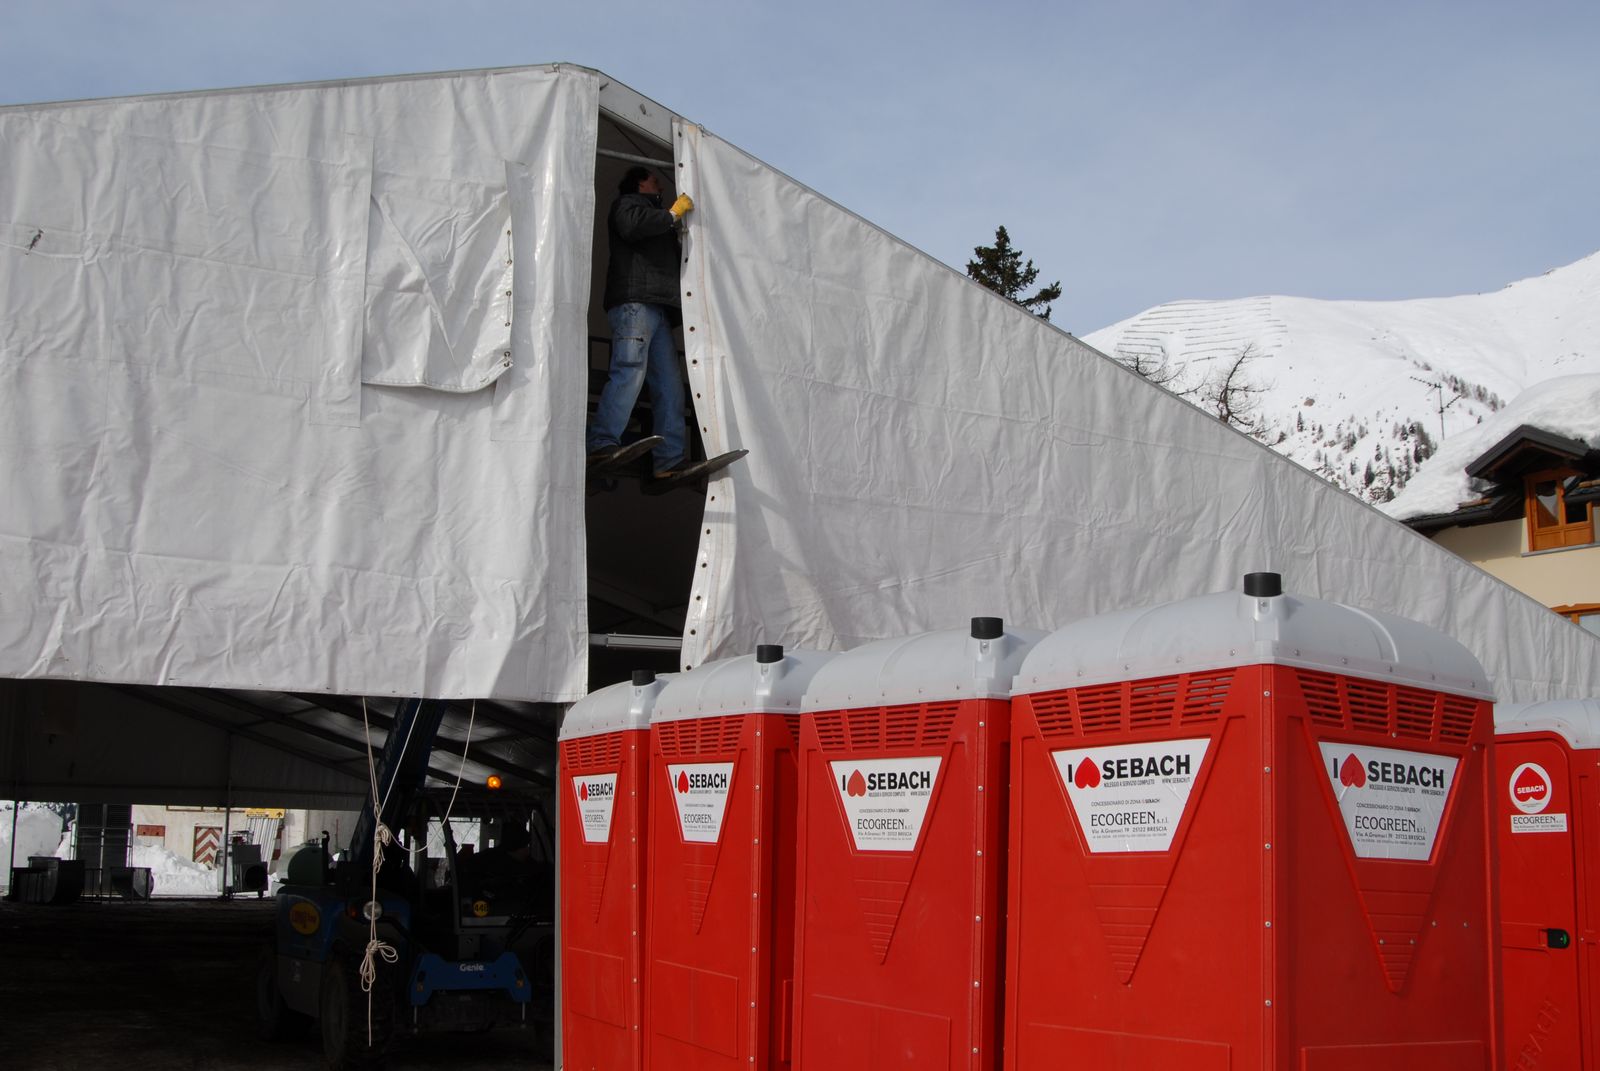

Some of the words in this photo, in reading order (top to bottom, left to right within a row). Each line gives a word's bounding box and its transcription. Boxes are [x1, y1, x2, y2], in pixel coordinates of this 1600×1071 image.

[1068, 764, 1073, 783] I
[1102, 754, 1190, 780] SEBACH
[1333, 758, 1338, 779] I
[1367, 761, 1444, 788] SEBACH
[689, 773, 727, 788] SEBACH
[842, 774, 846, 791] I
[867, 771, 930, 791] SEBACH
[588, 782, 613, 796] SEBACH
[1517, 785, 1544, 794] SEBACH
[684, 814, 712, 823] ECOGREEN
[857, 819, 905, 830] ECOGREEN
[1091, 811, 1156, 827] ECOGREEN
[1355, 816, 1416, 832] ECOGREEN
[1513, 816, 1556, 824] ECOGREEN
[459, 962, 485, 972] Genie
